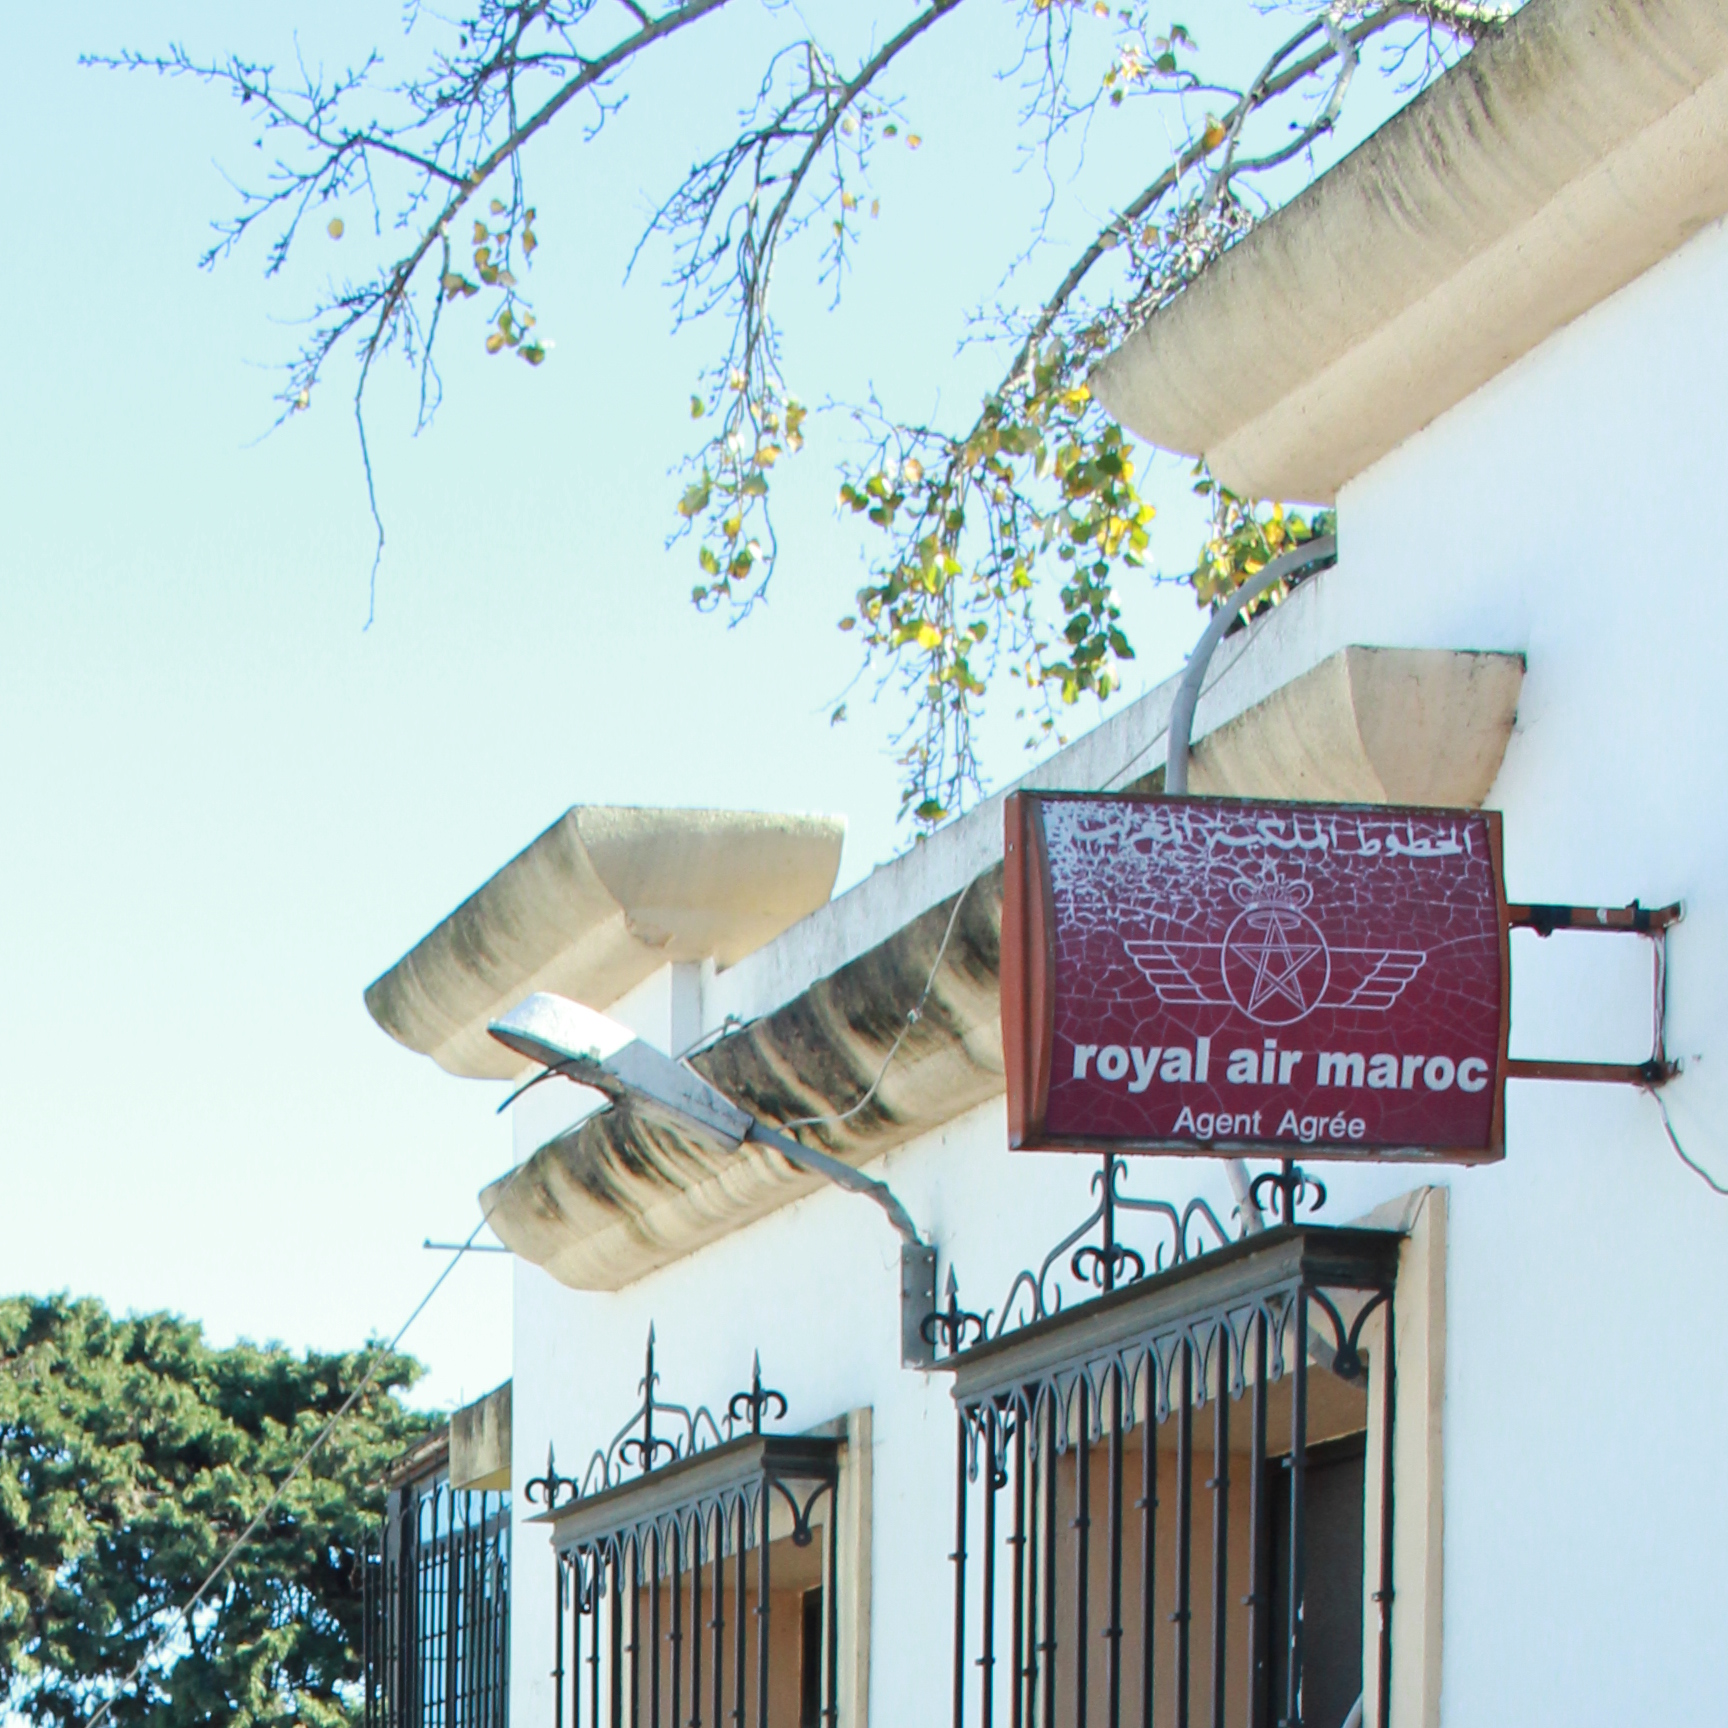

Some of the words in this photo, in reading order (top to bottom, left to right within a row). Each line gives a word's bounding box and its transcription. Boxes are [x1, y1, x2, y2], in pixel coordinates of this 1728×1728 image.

[1355, 815, 1472, 857] الخطوط
[1073, 1036, 1210, 1094] royal
[1227, 1038, 1303, 1086] air
[1317, 1051, 1489, 1093] maroc
[1172, 1106, 1262, 1140] Agent
[1277, 1108, 1366, 1143] Agrée
